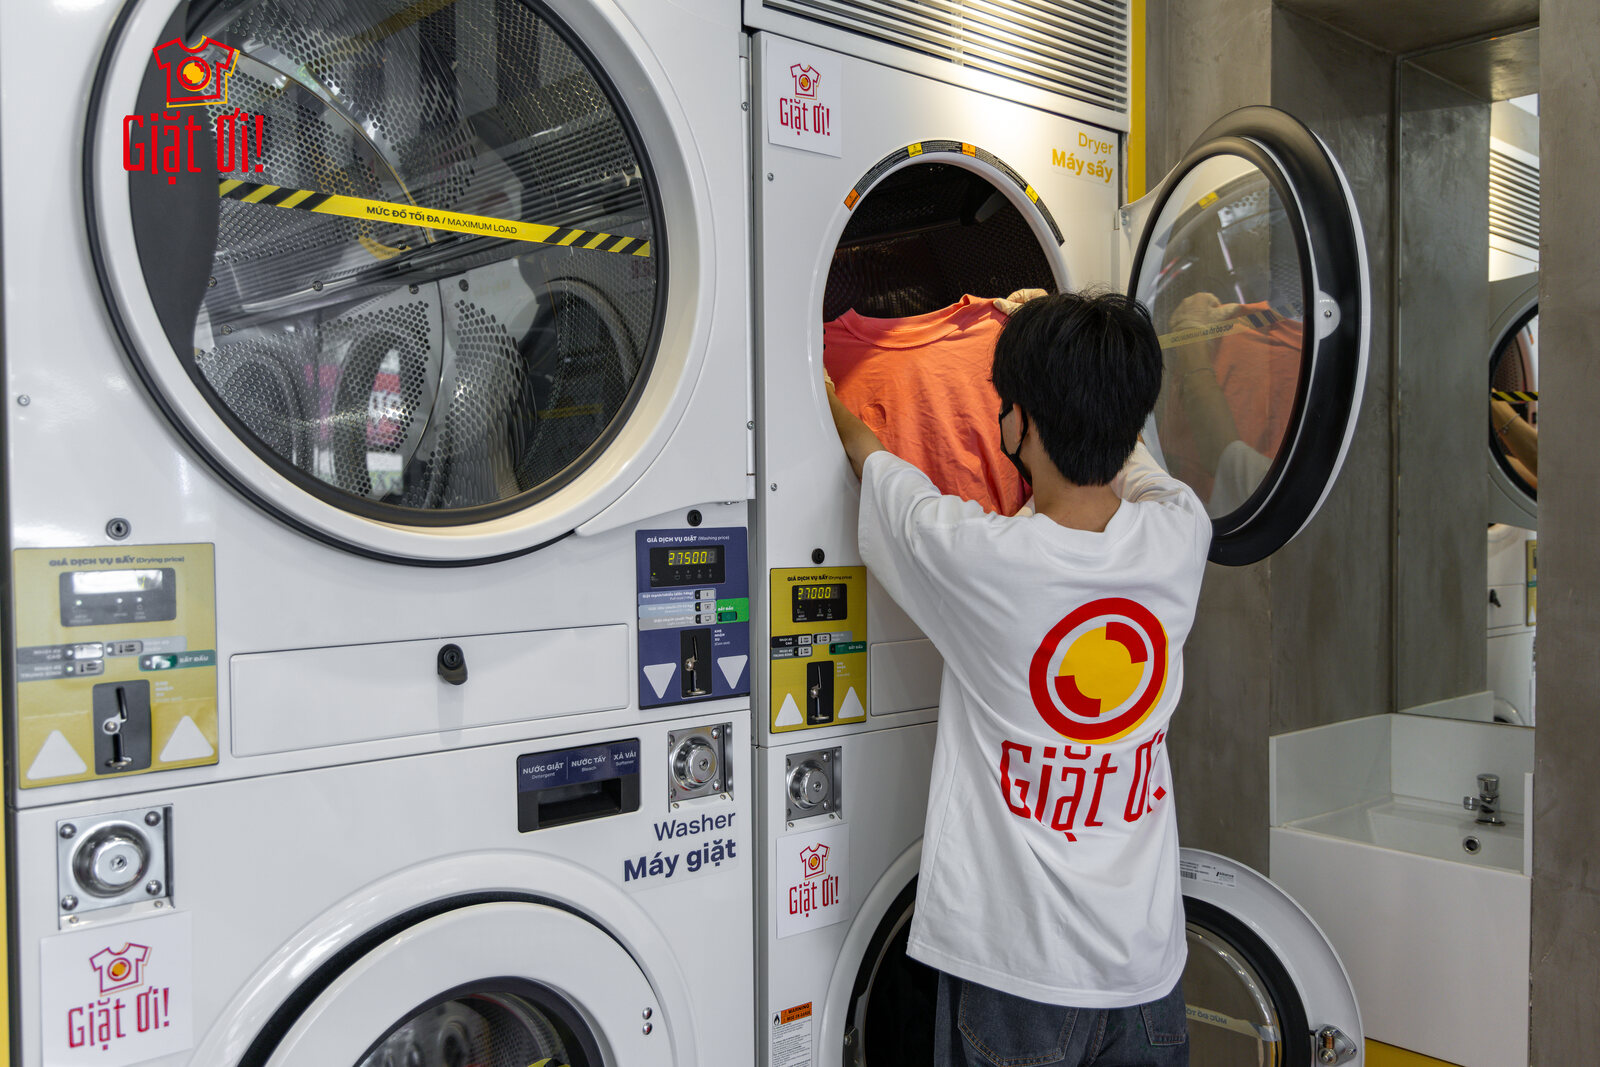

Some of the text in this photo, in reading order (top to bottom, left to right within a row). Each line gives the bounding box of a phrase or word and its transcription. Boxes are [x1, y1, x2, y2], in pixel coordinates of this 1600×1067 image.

[780, 97, 830, 136] Giặt Ơi!
[1078, 132, 1114, 155] Dryer
[1052, 148, 1084, 176] Máy
[1086, 160, 1113, 184] sấy
[366, 206, 390, 216] MỨC
[409, 211, 425, 222] TỐI
[427, 215, 440, 224] ĐA
[448, 217, 492, 231] MAXIMUM
[494, 224, 517, 234] LOAD
[668, 551, 708, 566] 27500
[798, 586, 832, 600] 27000
[1000, 740, 1118, 842] Giặt
[654, 812, 736, 841] Washer
[624, 838, 736, 882] Máy giặt
[789, 874, 839, 918] Giặt Ơi!
[68, 986, 170, 1051] Giặt Ơi!
